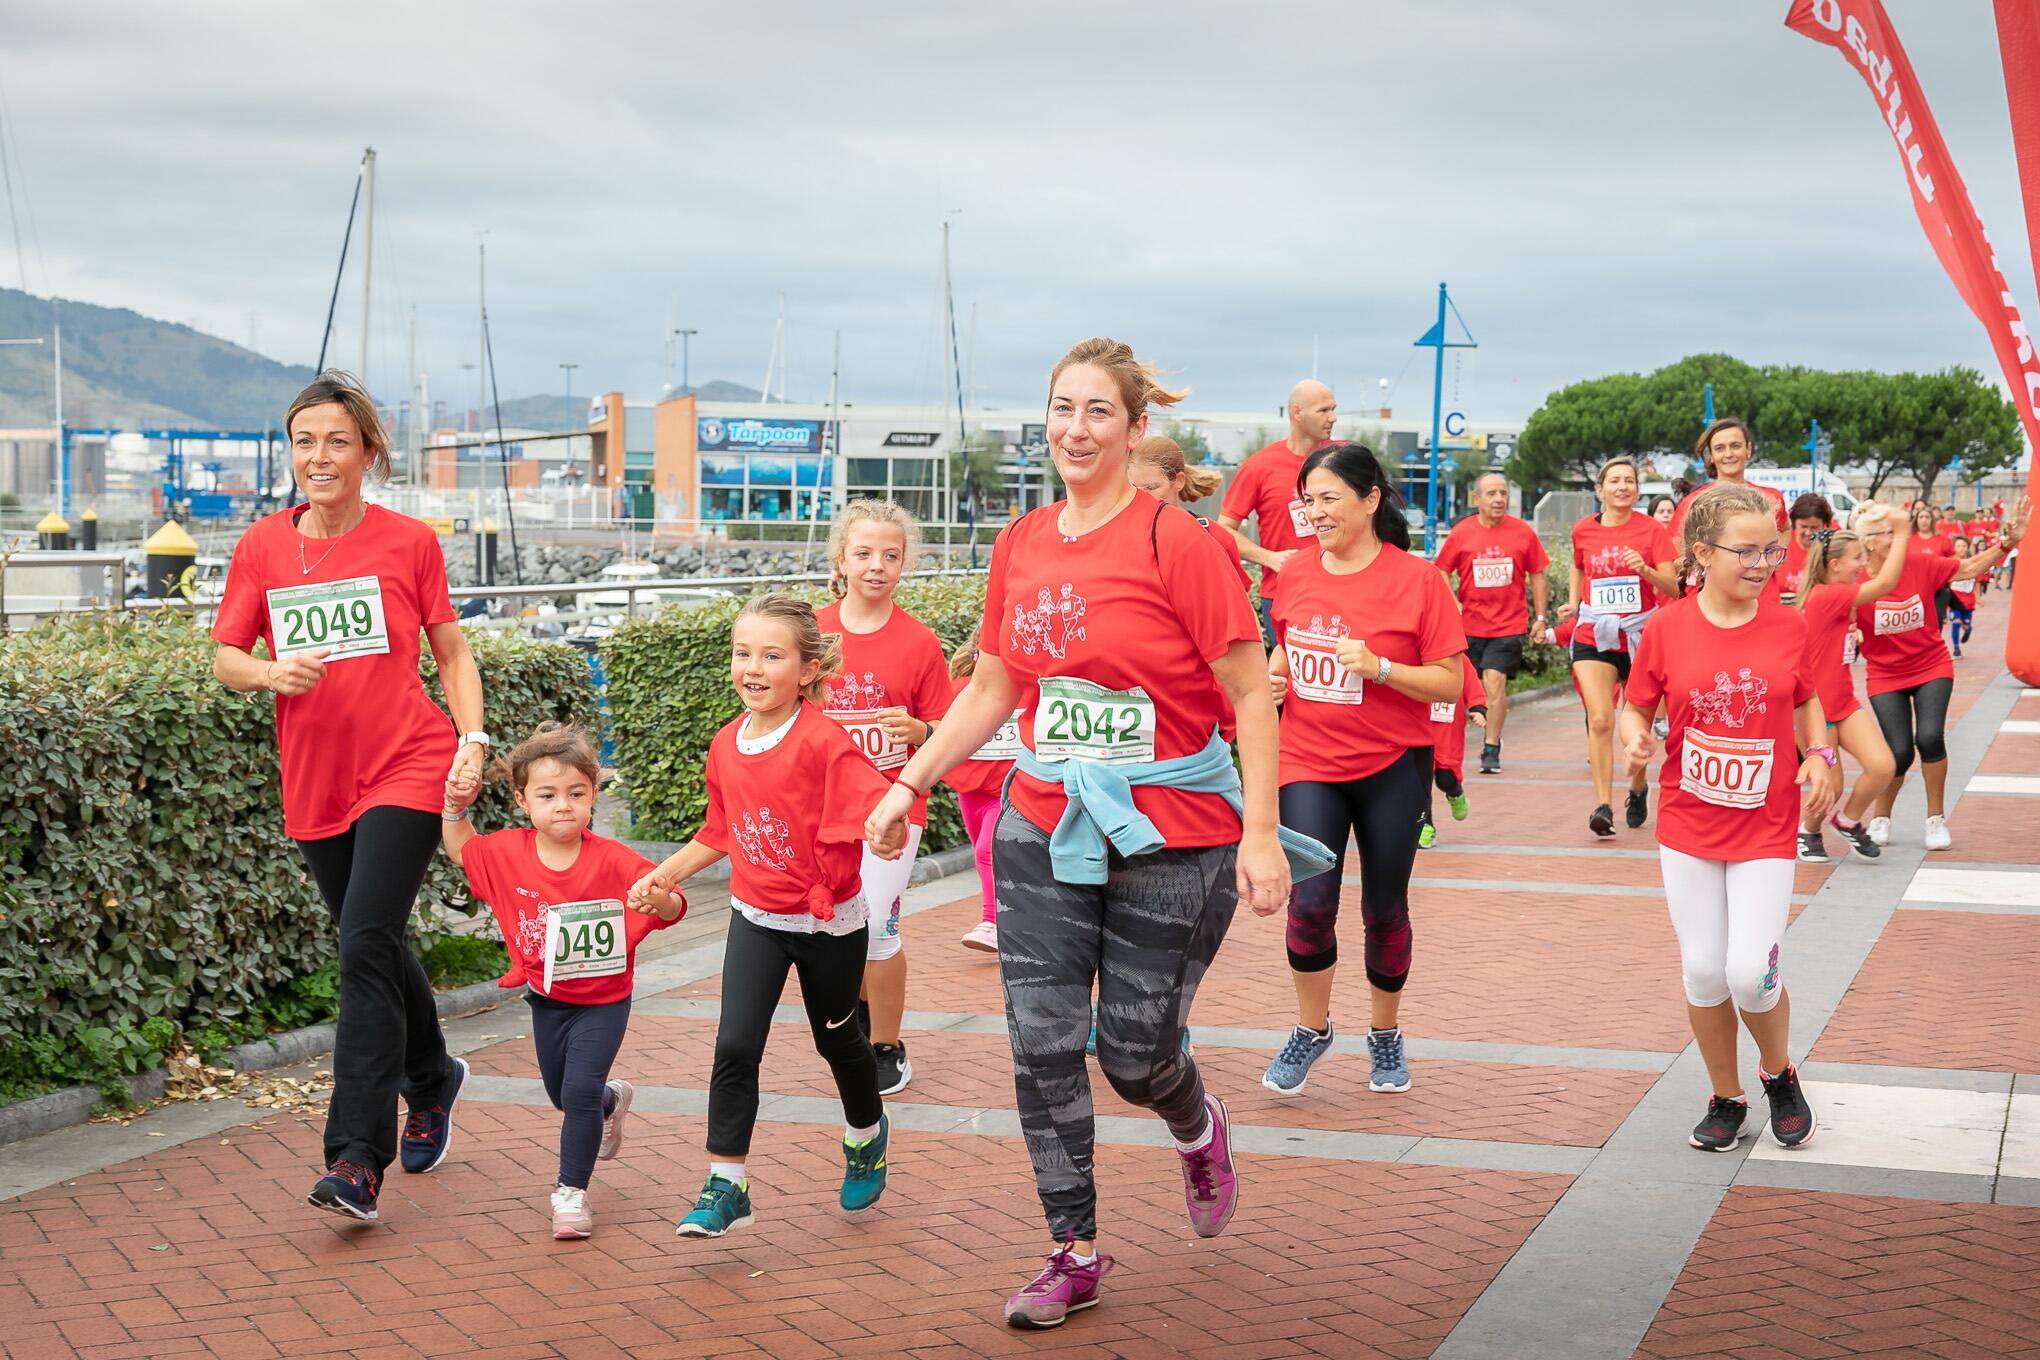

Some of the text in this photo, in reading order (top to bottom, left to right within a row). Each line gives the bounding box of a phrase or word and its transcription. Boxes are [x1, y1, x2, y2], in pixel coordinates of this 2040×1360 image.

[729, 423, 808, 445] Tarpoon
[1445, 412, 1465, 436] C
[1478, 566, 1508, 580] 3004
[1598, 587, 1635, 604] 1018
[284, 600, 372, 646] 2049
[1881, 607, 1920, 628] 3005
[1434, 701, 1449, 713] 04
[1047, 700, 1142, 744] 2042
[993, 725, 1017, 742] 63
[1689, 749, 1764, 791] 3007
[555, 920, 614, 962] 049
